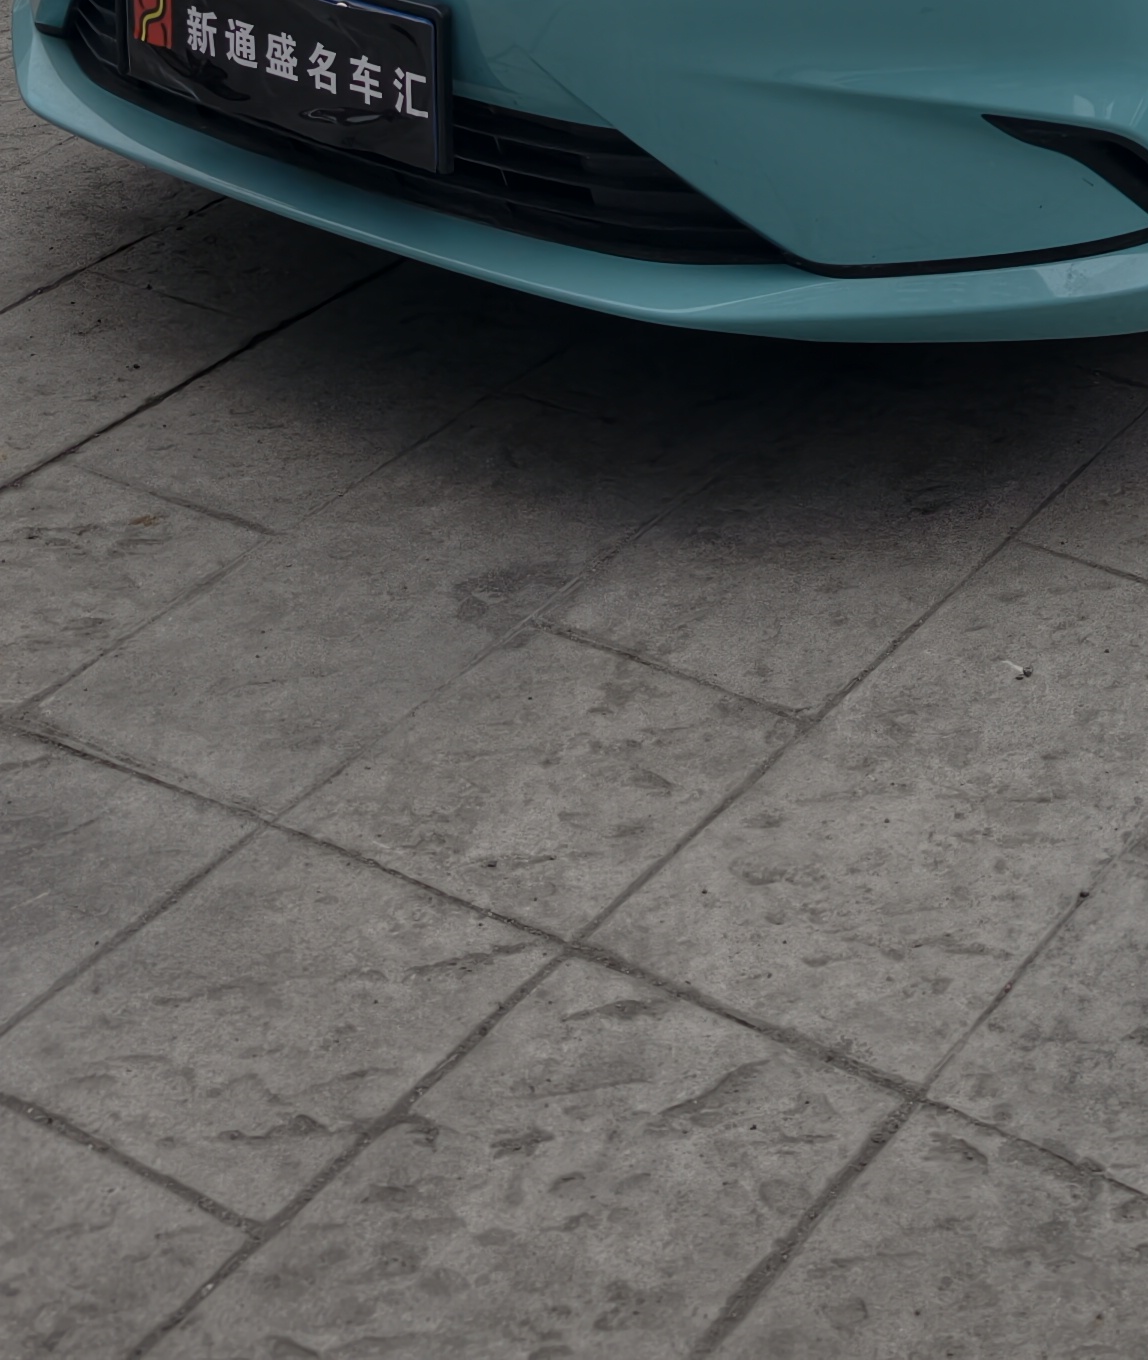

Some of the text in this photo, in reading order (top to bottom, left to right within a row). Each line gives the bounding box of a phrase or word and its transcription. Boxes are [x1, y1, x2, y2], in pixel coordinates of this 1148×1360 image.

[185, 5, 429, 119] 新通盛名车汇
